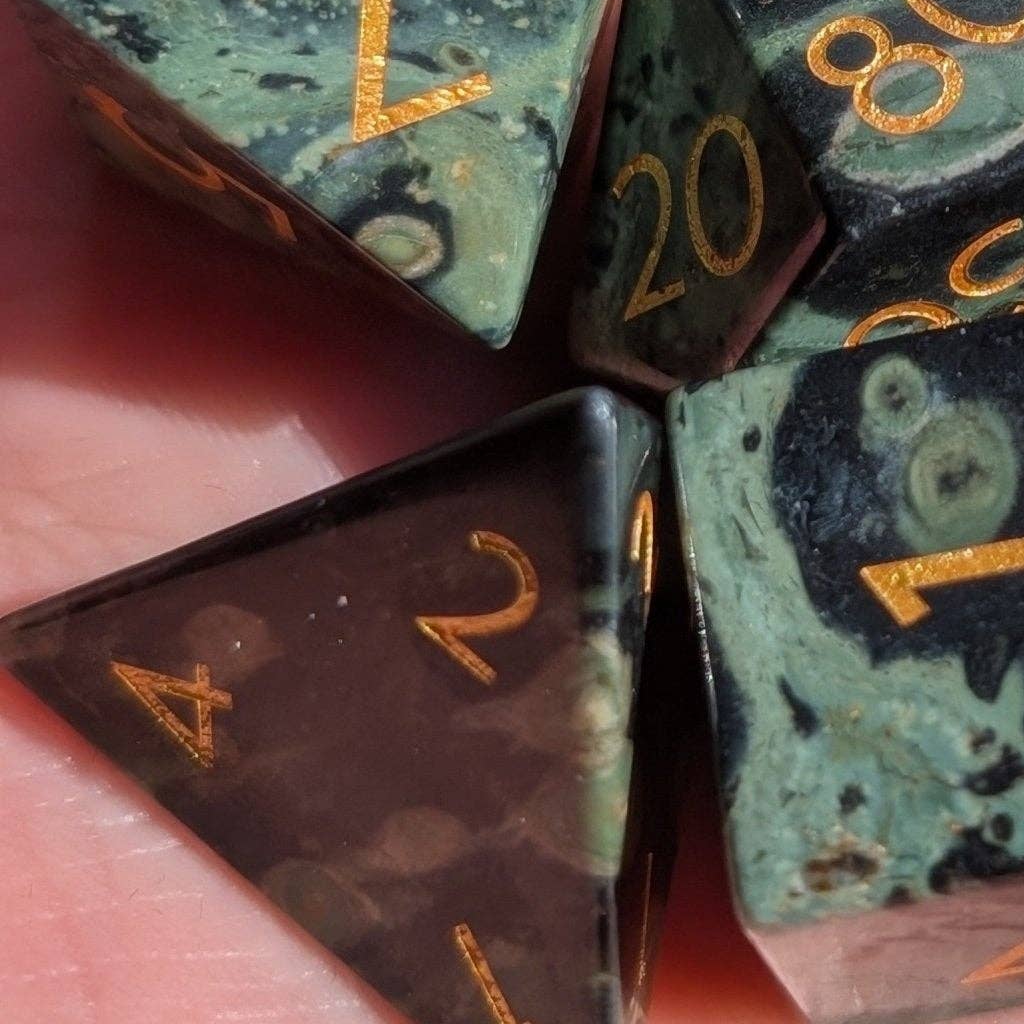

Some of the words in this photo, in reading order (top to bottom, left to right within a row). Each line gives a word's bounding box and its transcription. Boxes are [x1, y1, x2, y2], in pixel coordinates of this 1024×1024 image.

[611, 112, 764, 321] 20
[414, 530, 540, 686] 2
[110, 661, 234, 767] 4
